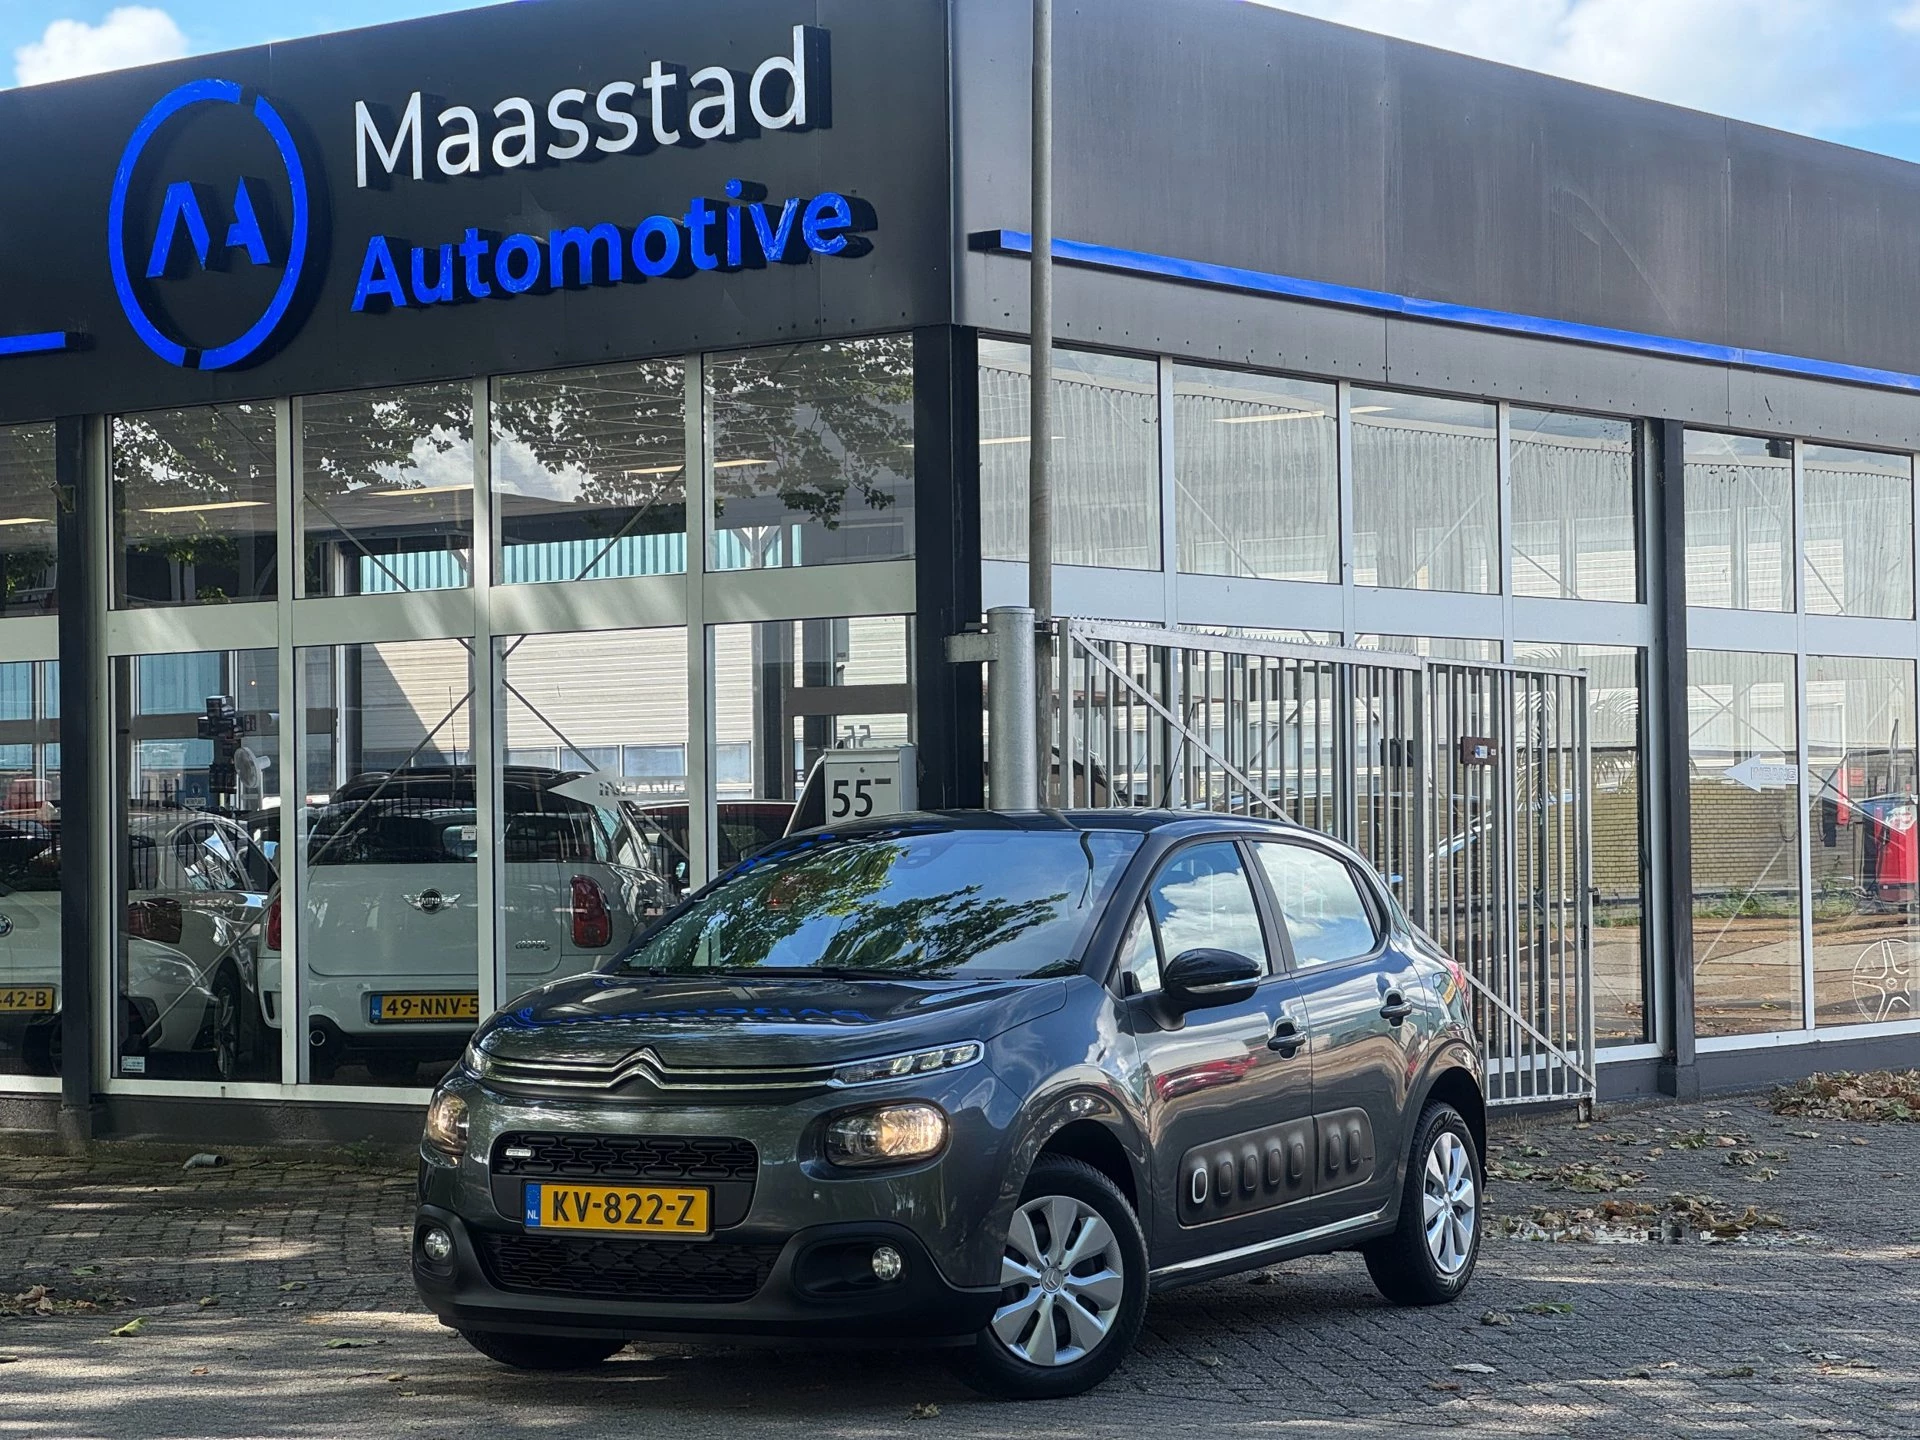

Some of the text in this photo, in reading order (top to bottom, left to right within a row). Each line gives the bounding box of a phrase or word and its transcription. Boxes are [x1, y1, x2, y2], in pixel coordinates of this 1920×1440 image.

[355, 24, 806, 188] Maasstad
[351, 178, 852, 312] Automotive
[832, 779, 873, 818] 55
[386, 997, 479, 1016] 49-NNV-5
[527, 1209, 539, 1220] NL
[552, 1190, 695, 1226] KV-822-Z
